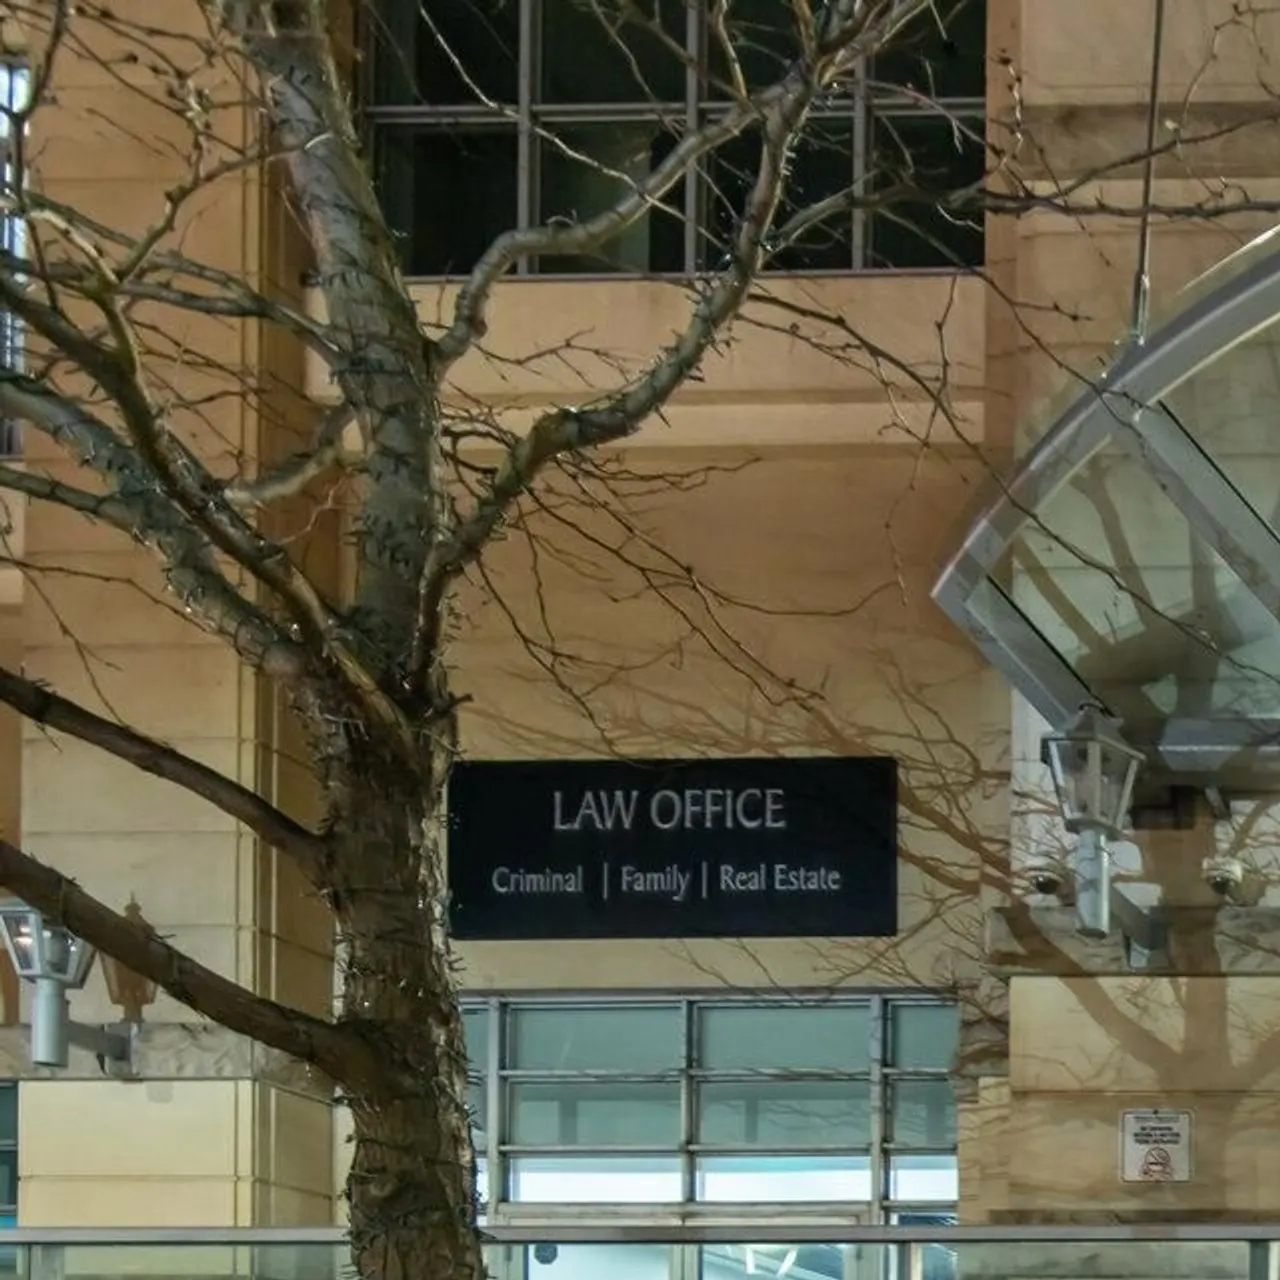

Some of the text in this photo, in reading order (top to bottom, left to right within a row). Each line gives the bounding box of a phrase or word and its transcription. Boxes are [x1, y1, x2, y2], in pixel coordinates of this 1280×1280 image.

[553, 788, 787, 830] LAW OFFICE
[491, 866, 584, 894] Criminal
[620, 864, 690, 900] Family
[719, 864, 767, 891] Real
[773, 864, 842, 891] Estate
